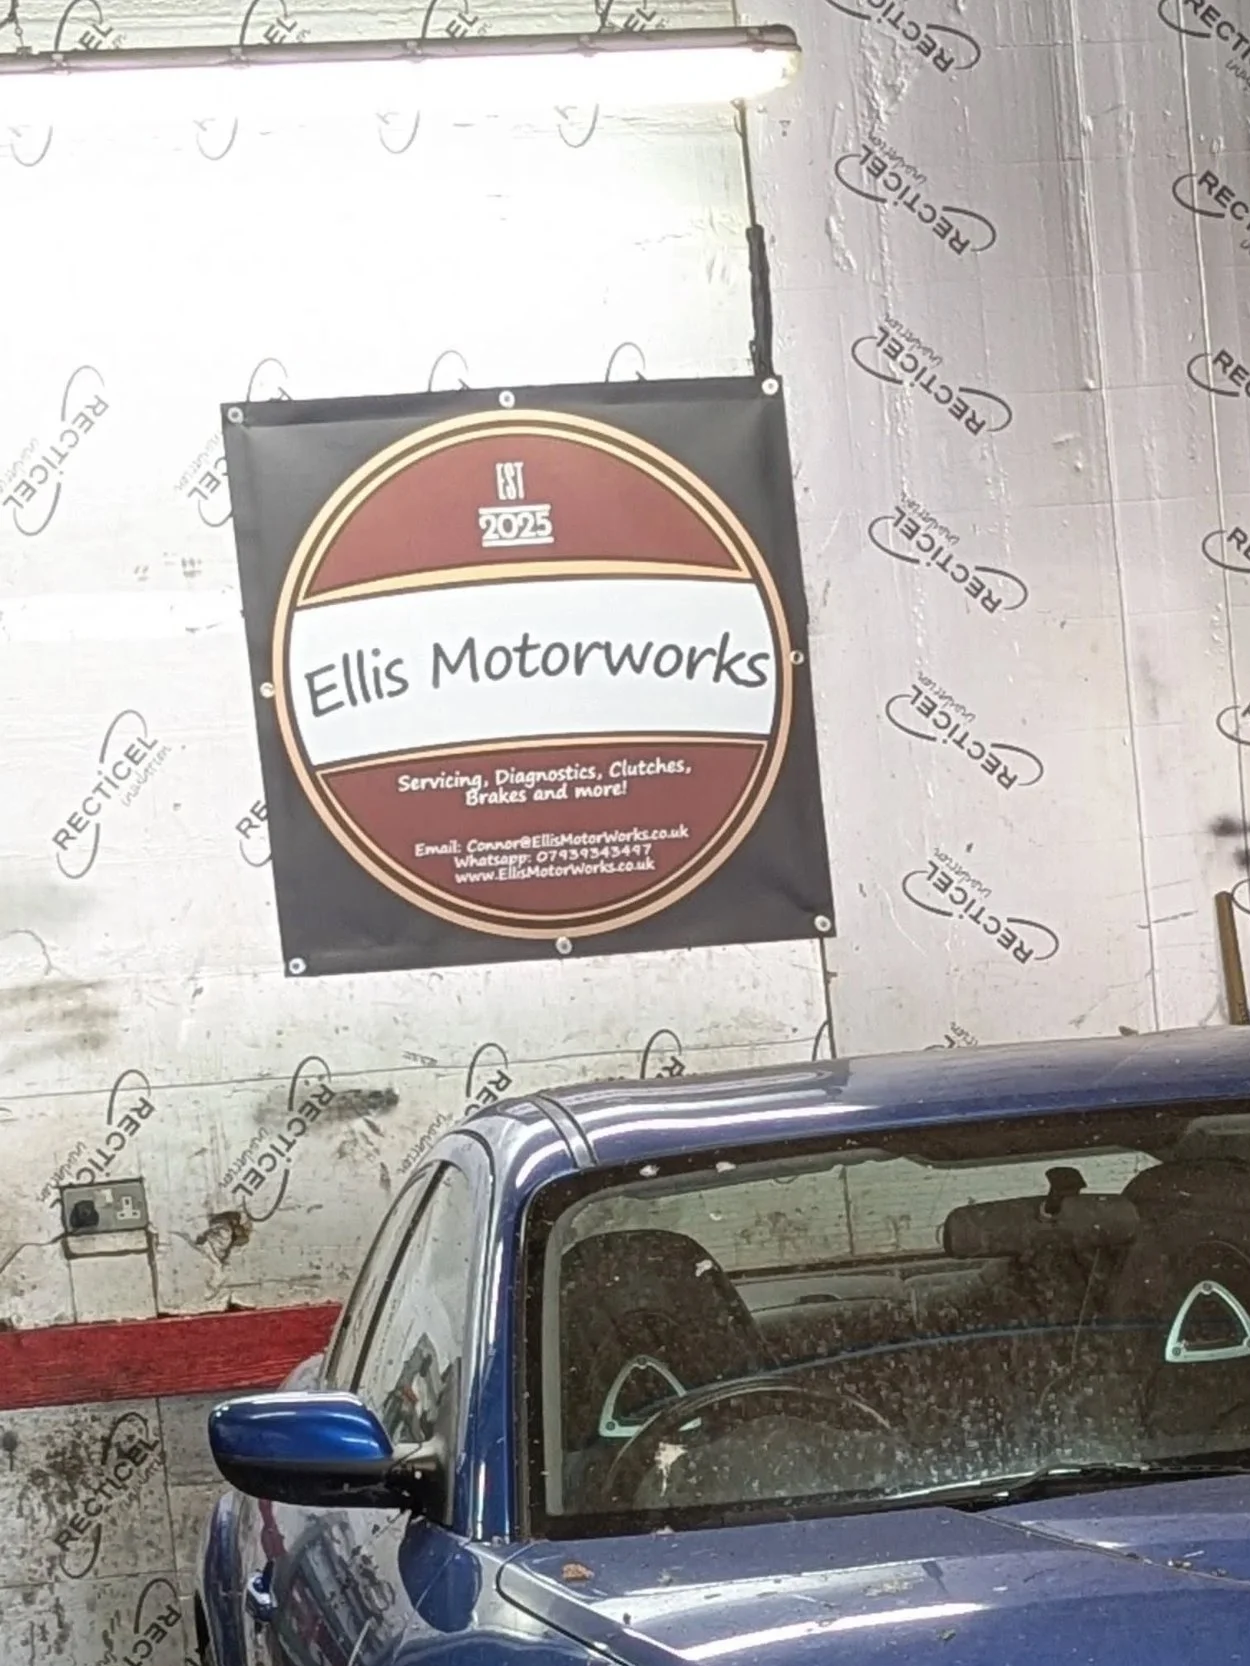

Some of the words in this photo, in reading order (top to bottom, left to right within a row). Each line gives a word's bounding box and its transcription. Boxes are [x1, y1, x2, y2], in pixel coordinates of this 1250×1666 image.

[859, 144, 970, 255] RECTICEL
[876, 325, 986, 436] RECTICEL
[3, 395, 109, 509] RECTICEL
[495, 461, 524, 500] EST
[479, 511, 553, 540] 2025
[893, 506, 1003, 614] RECTICEL
[304, 648, 409, 717] Ellis
[431, 631, 770, 689] Motorworks
[398, 771, 489, 792] Servicing,
[495, 763, 603, 788] Diagnostics,
[609, 757, 692, 777] Clutches,
[910, 684, 1018, 790] RECTICEL
[52, 737, 159, 851] RECTICEL
[465, 787, 527, 806] Brakes
[533, 783, 568, 801] and
[575, 781, 628, 799] more!
[414, 840, 462, 857] Email:
[926, 860, 1034, 965] RECTICEL
[231, 1083, 336, 1197] RECTICEL
